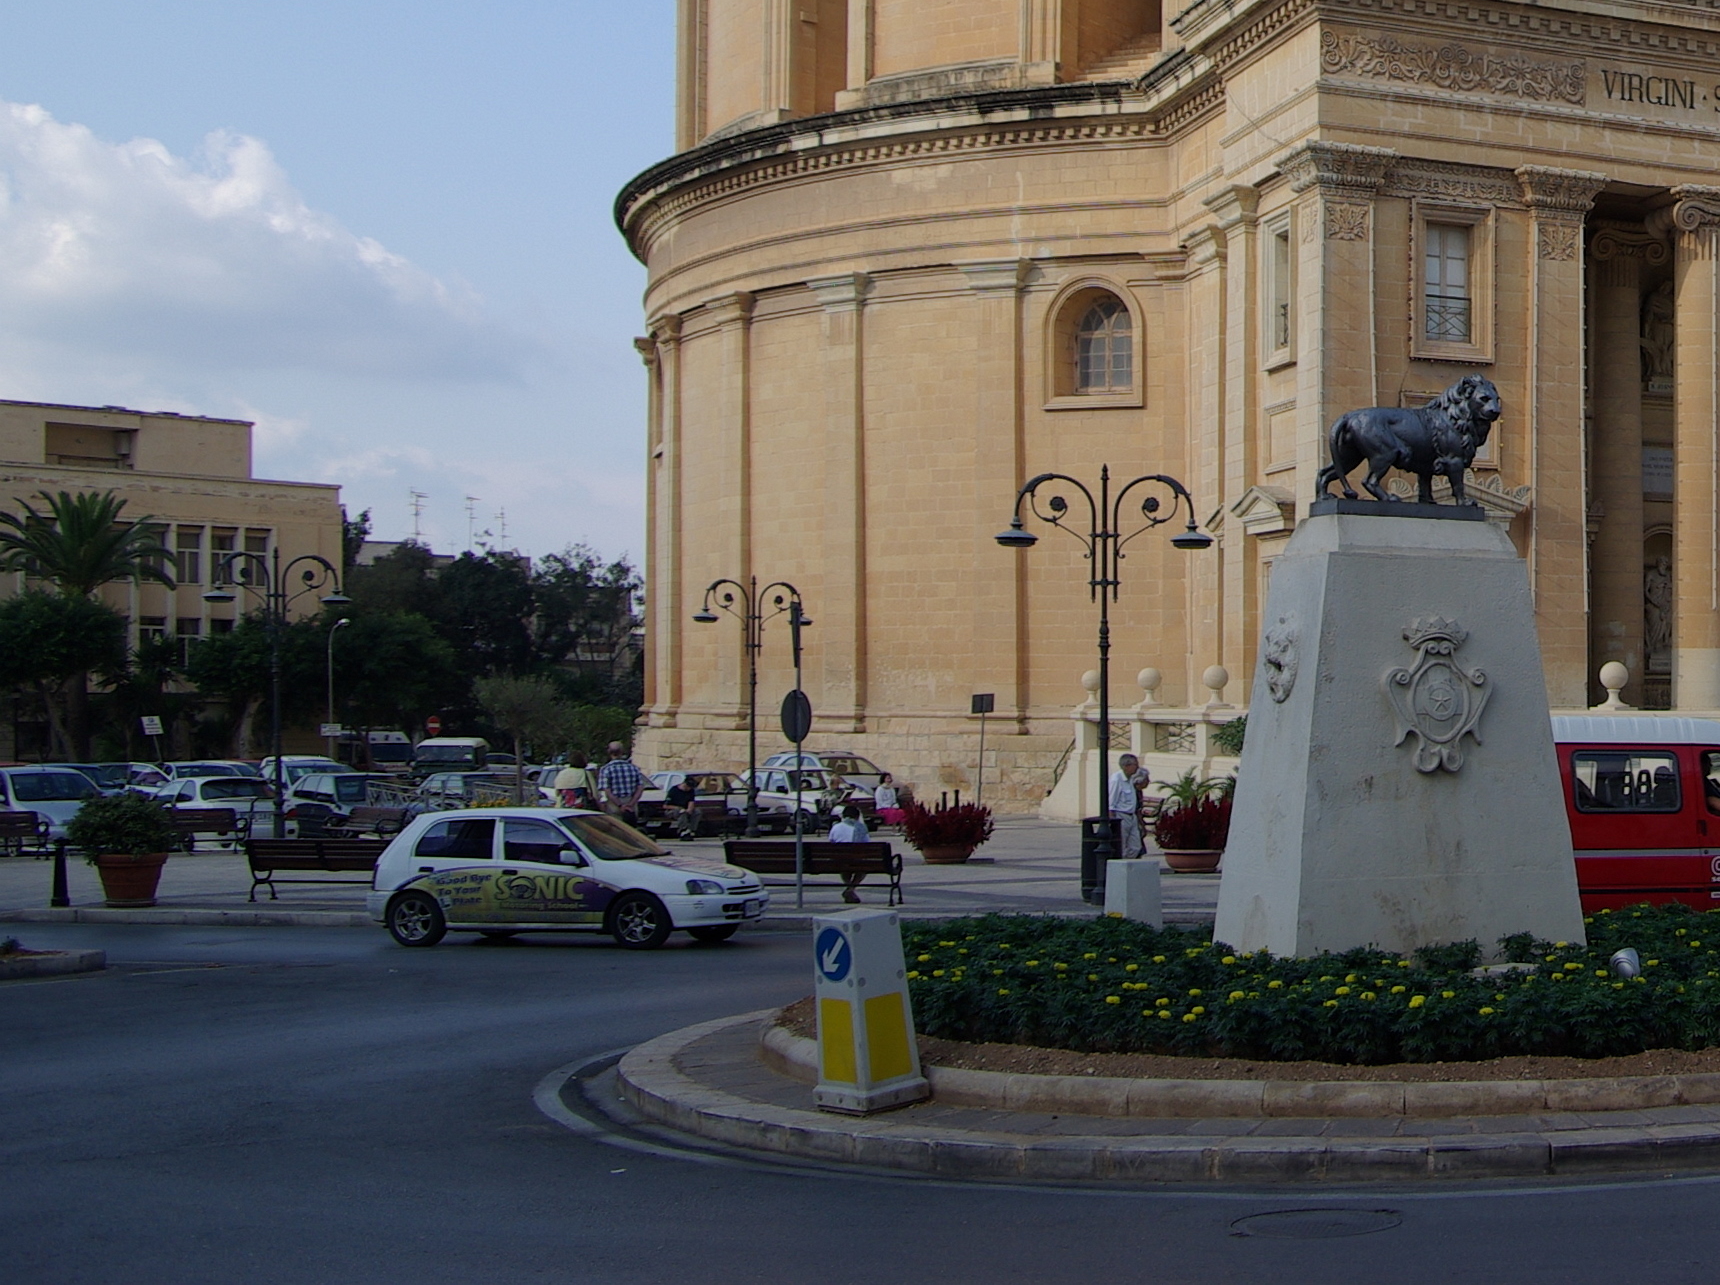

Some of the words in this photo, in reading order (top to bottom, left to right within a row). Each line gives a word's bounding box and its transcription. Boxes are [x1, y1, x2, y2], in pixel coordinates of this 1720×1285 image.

[1601, 69, 1696, 110] VIRGINI
[436, 875, 468, 885] Good
[470, 874, 492, 883] Bye
[436, 888, 452, 896] To
[453, 886, 482, 895] Your
[494, 875, 585, 901] SONIC
[453, 897, 483, 905] Plate
[547, 902, 579, 910] School
